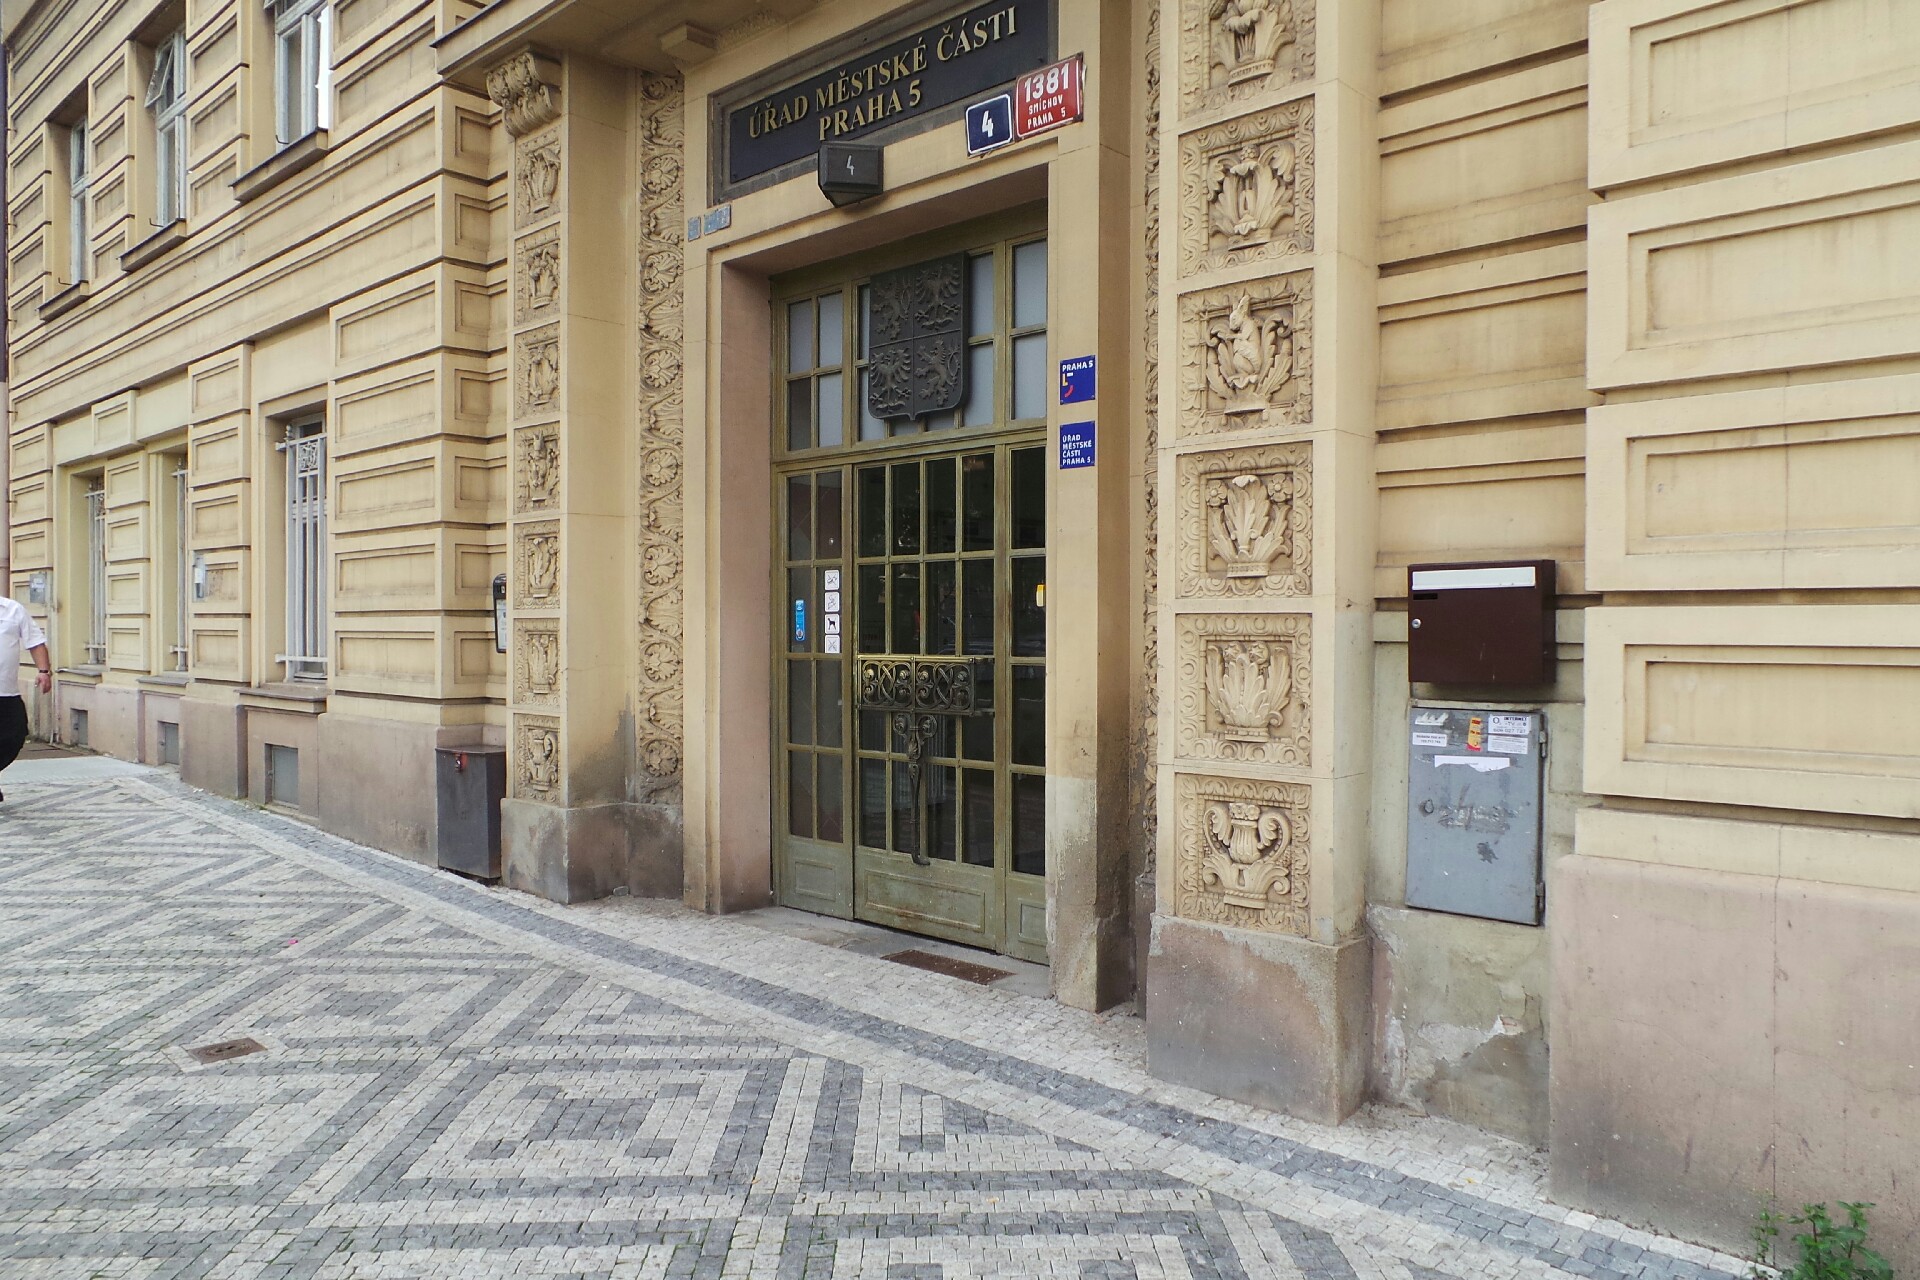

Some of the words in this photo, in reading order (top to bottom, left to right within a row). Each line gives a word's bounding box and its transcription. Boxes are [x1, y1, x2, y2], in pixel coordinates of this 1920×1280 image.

[750, 95, 809, 139] ÚŘAD
[816, 37, 928, 112] MĚSTSKÉ
[937, 6, 1017, 62] ČÁSTI
[1024, 63, 1070, 103] 1381
[819, 89, 904, 141] PRAHA
[909, 79, 921, 107] 5
[1028, 94, 1063, 115] SMÍCHOV
[981, 110, 994, 138] 4
[1027, 112, 1054, 129] PRAHA
[1060, 106, 1066, 118] 5
[846, 155, 854, 175] 4
[1062, 361, 1088, 372] PRAHA
[1088, 360, 1094, 368] 5
[1062, 457, 1085, 465] PRAHA
